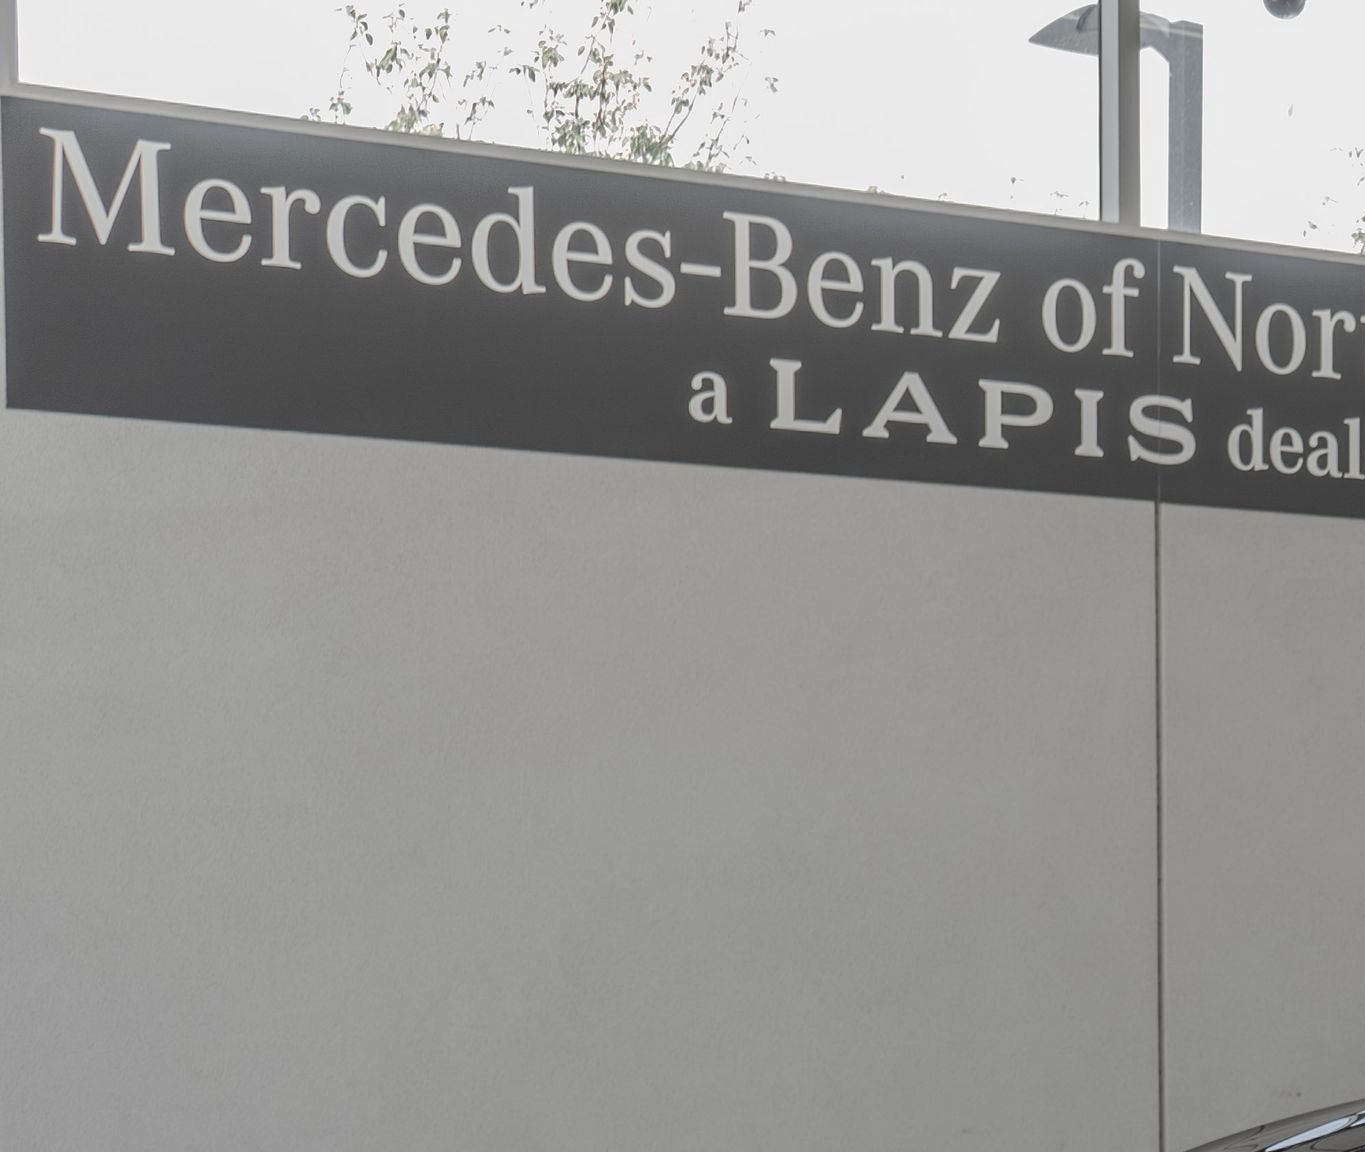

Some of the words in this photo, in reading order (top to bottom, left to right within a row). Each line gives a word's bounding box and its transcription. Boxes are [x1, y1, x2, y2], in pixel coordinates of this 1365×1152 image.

[36, 125, 1001, 344] Mercedes-Benz
[1041, 257, 1146, 358] of
[688, 371, 733, 425] a
[769, 357, 1196, 465] LAPIS
